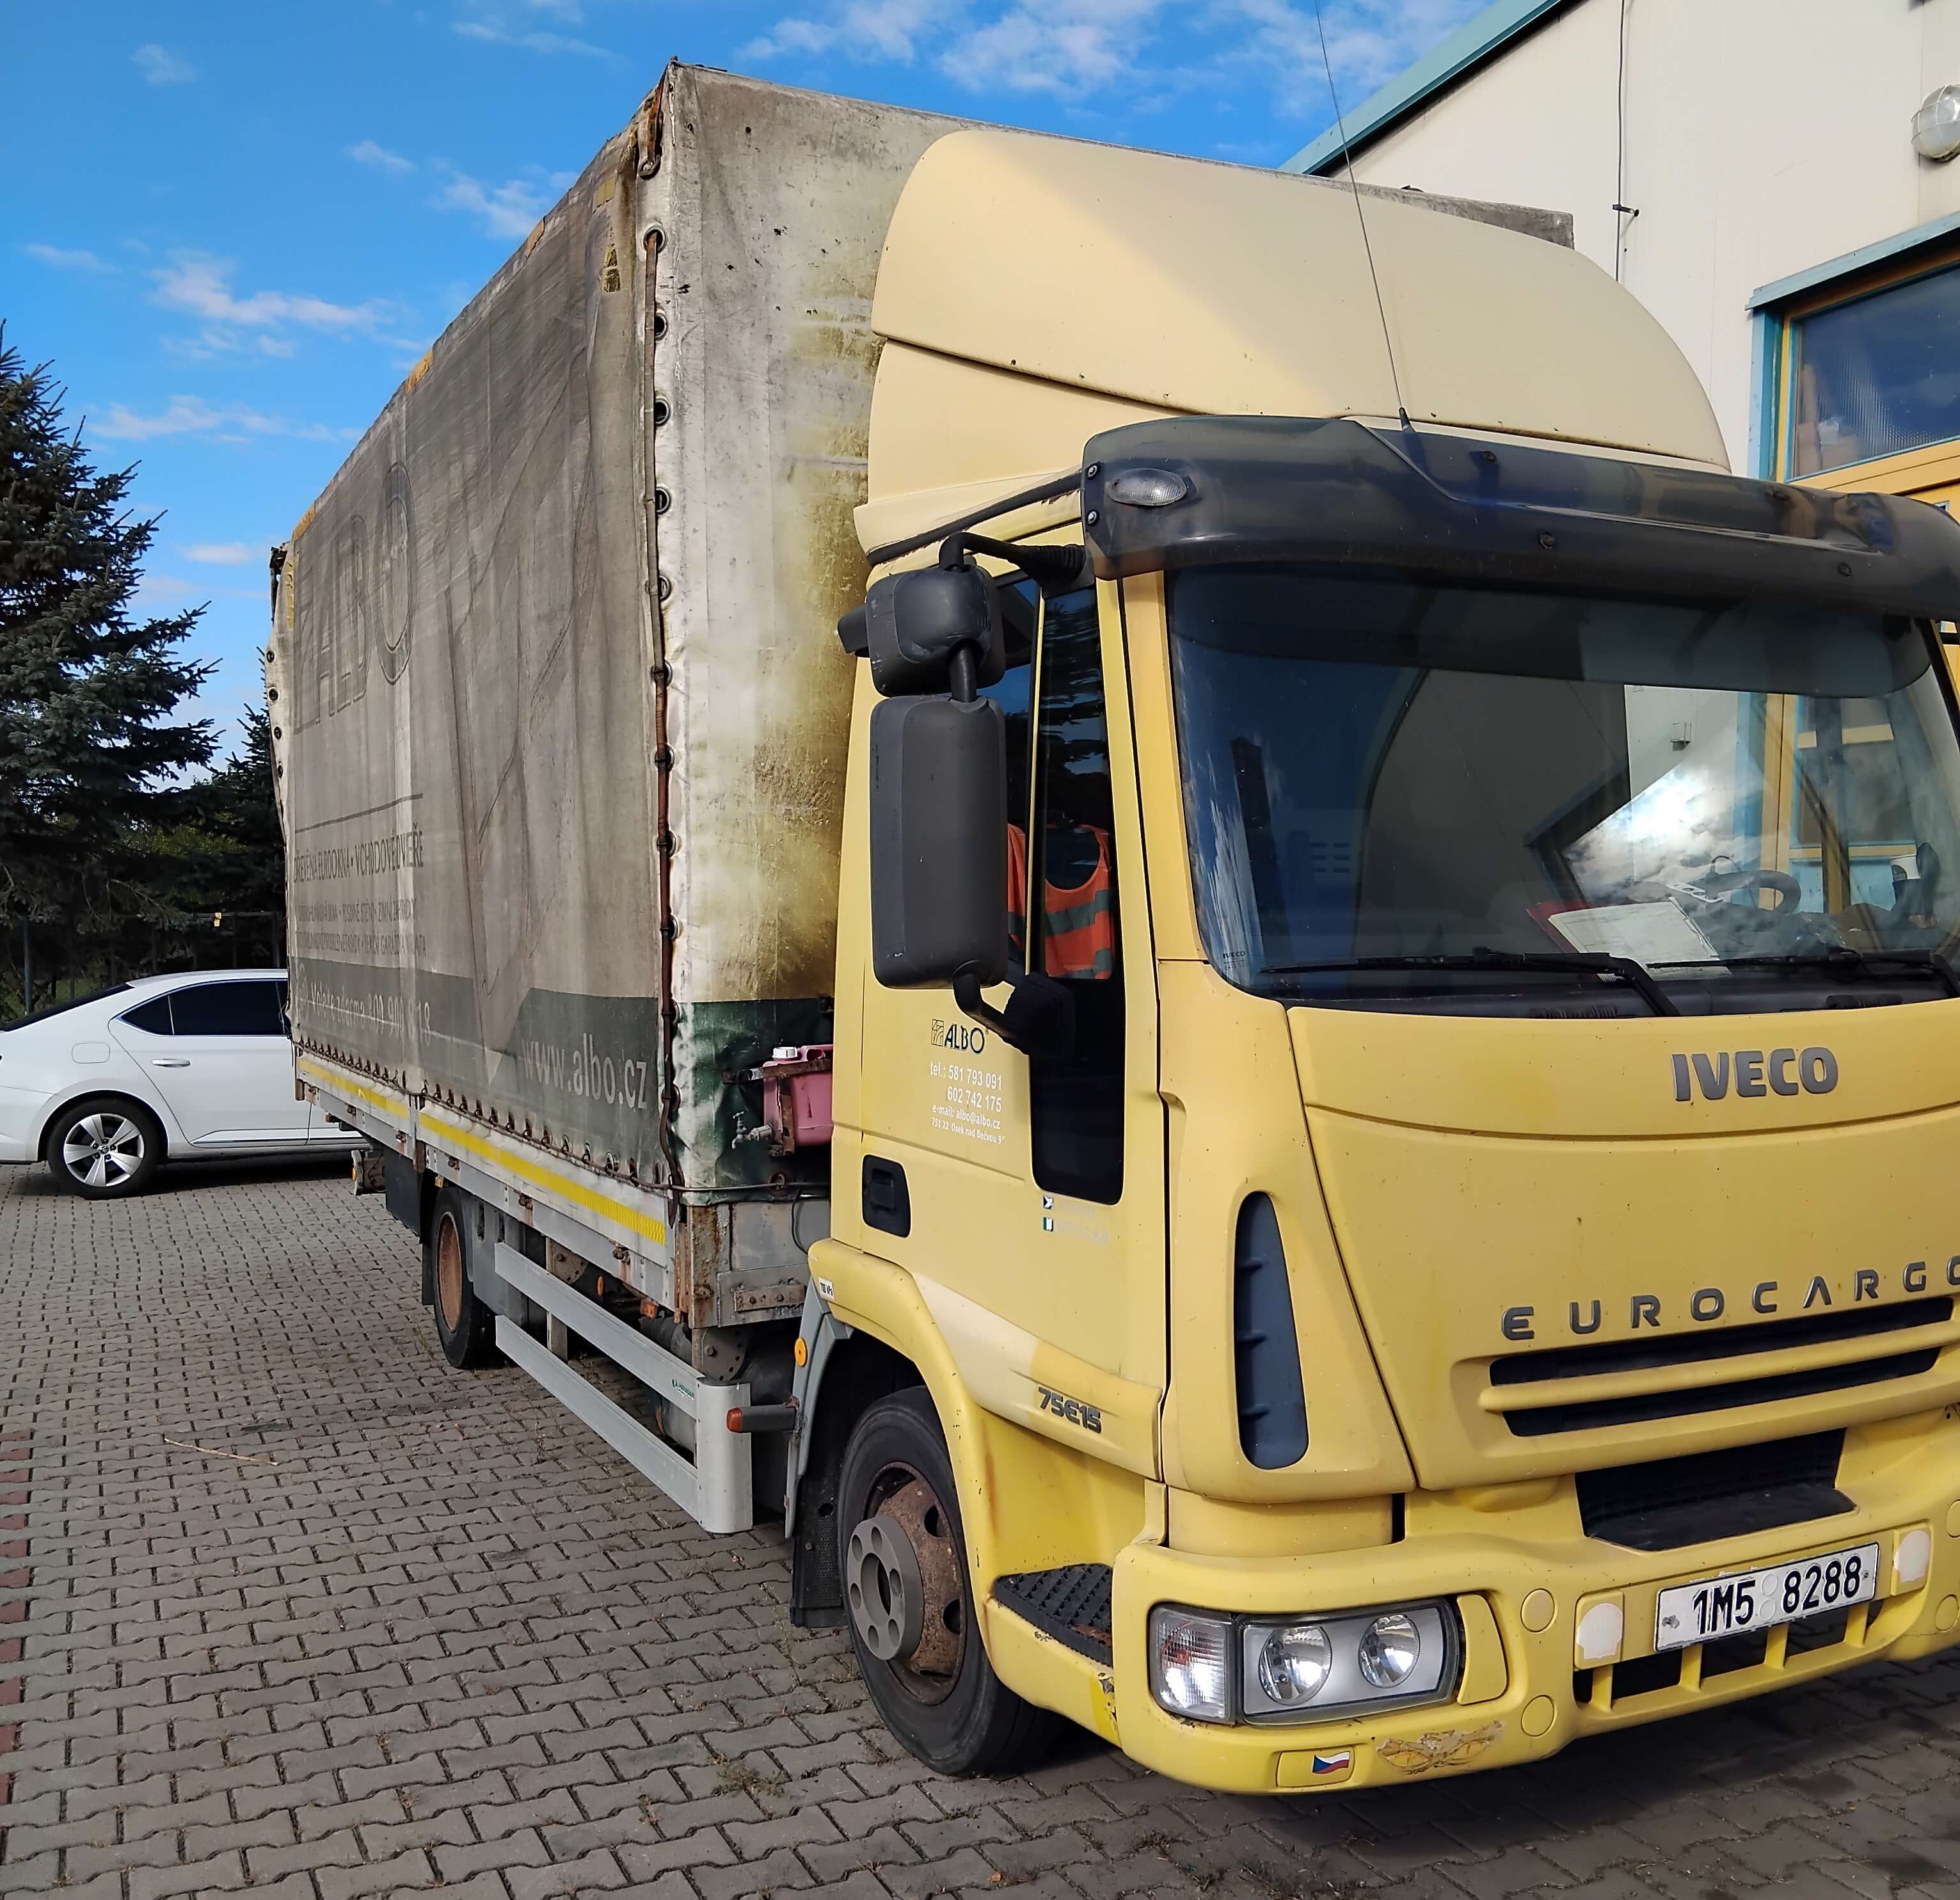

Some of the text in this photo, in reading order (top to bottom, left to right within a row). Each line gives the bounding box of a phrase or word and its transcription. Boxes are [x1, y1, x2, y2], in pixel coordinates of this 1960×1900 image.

[944, 1023, 985, 1054] ALBO
[521, 1032, 648, 1110] www.albo.cz
[930, 1062, 1002, 1090] tel.: 581 793 091
[1670, 1046, 1839, 1102] IVECO
[947, 1086, 1002, 1113] 602 742 175
[932, 1104, 1001, 1130] e-mail: albo@albo.cz
[932, 1117, 941, 1128] 751
[943, 1120, 950, 1130] 22
[951, 1123, 964, 1135] Osek
[965, 1128, 976, 1138] nad
[976, 1130, 997, 1144] Bečvou
[1038, 1386, 1102, 1434] 75E15
[1692, 1554, 1862, 1635] 1M5 8288
